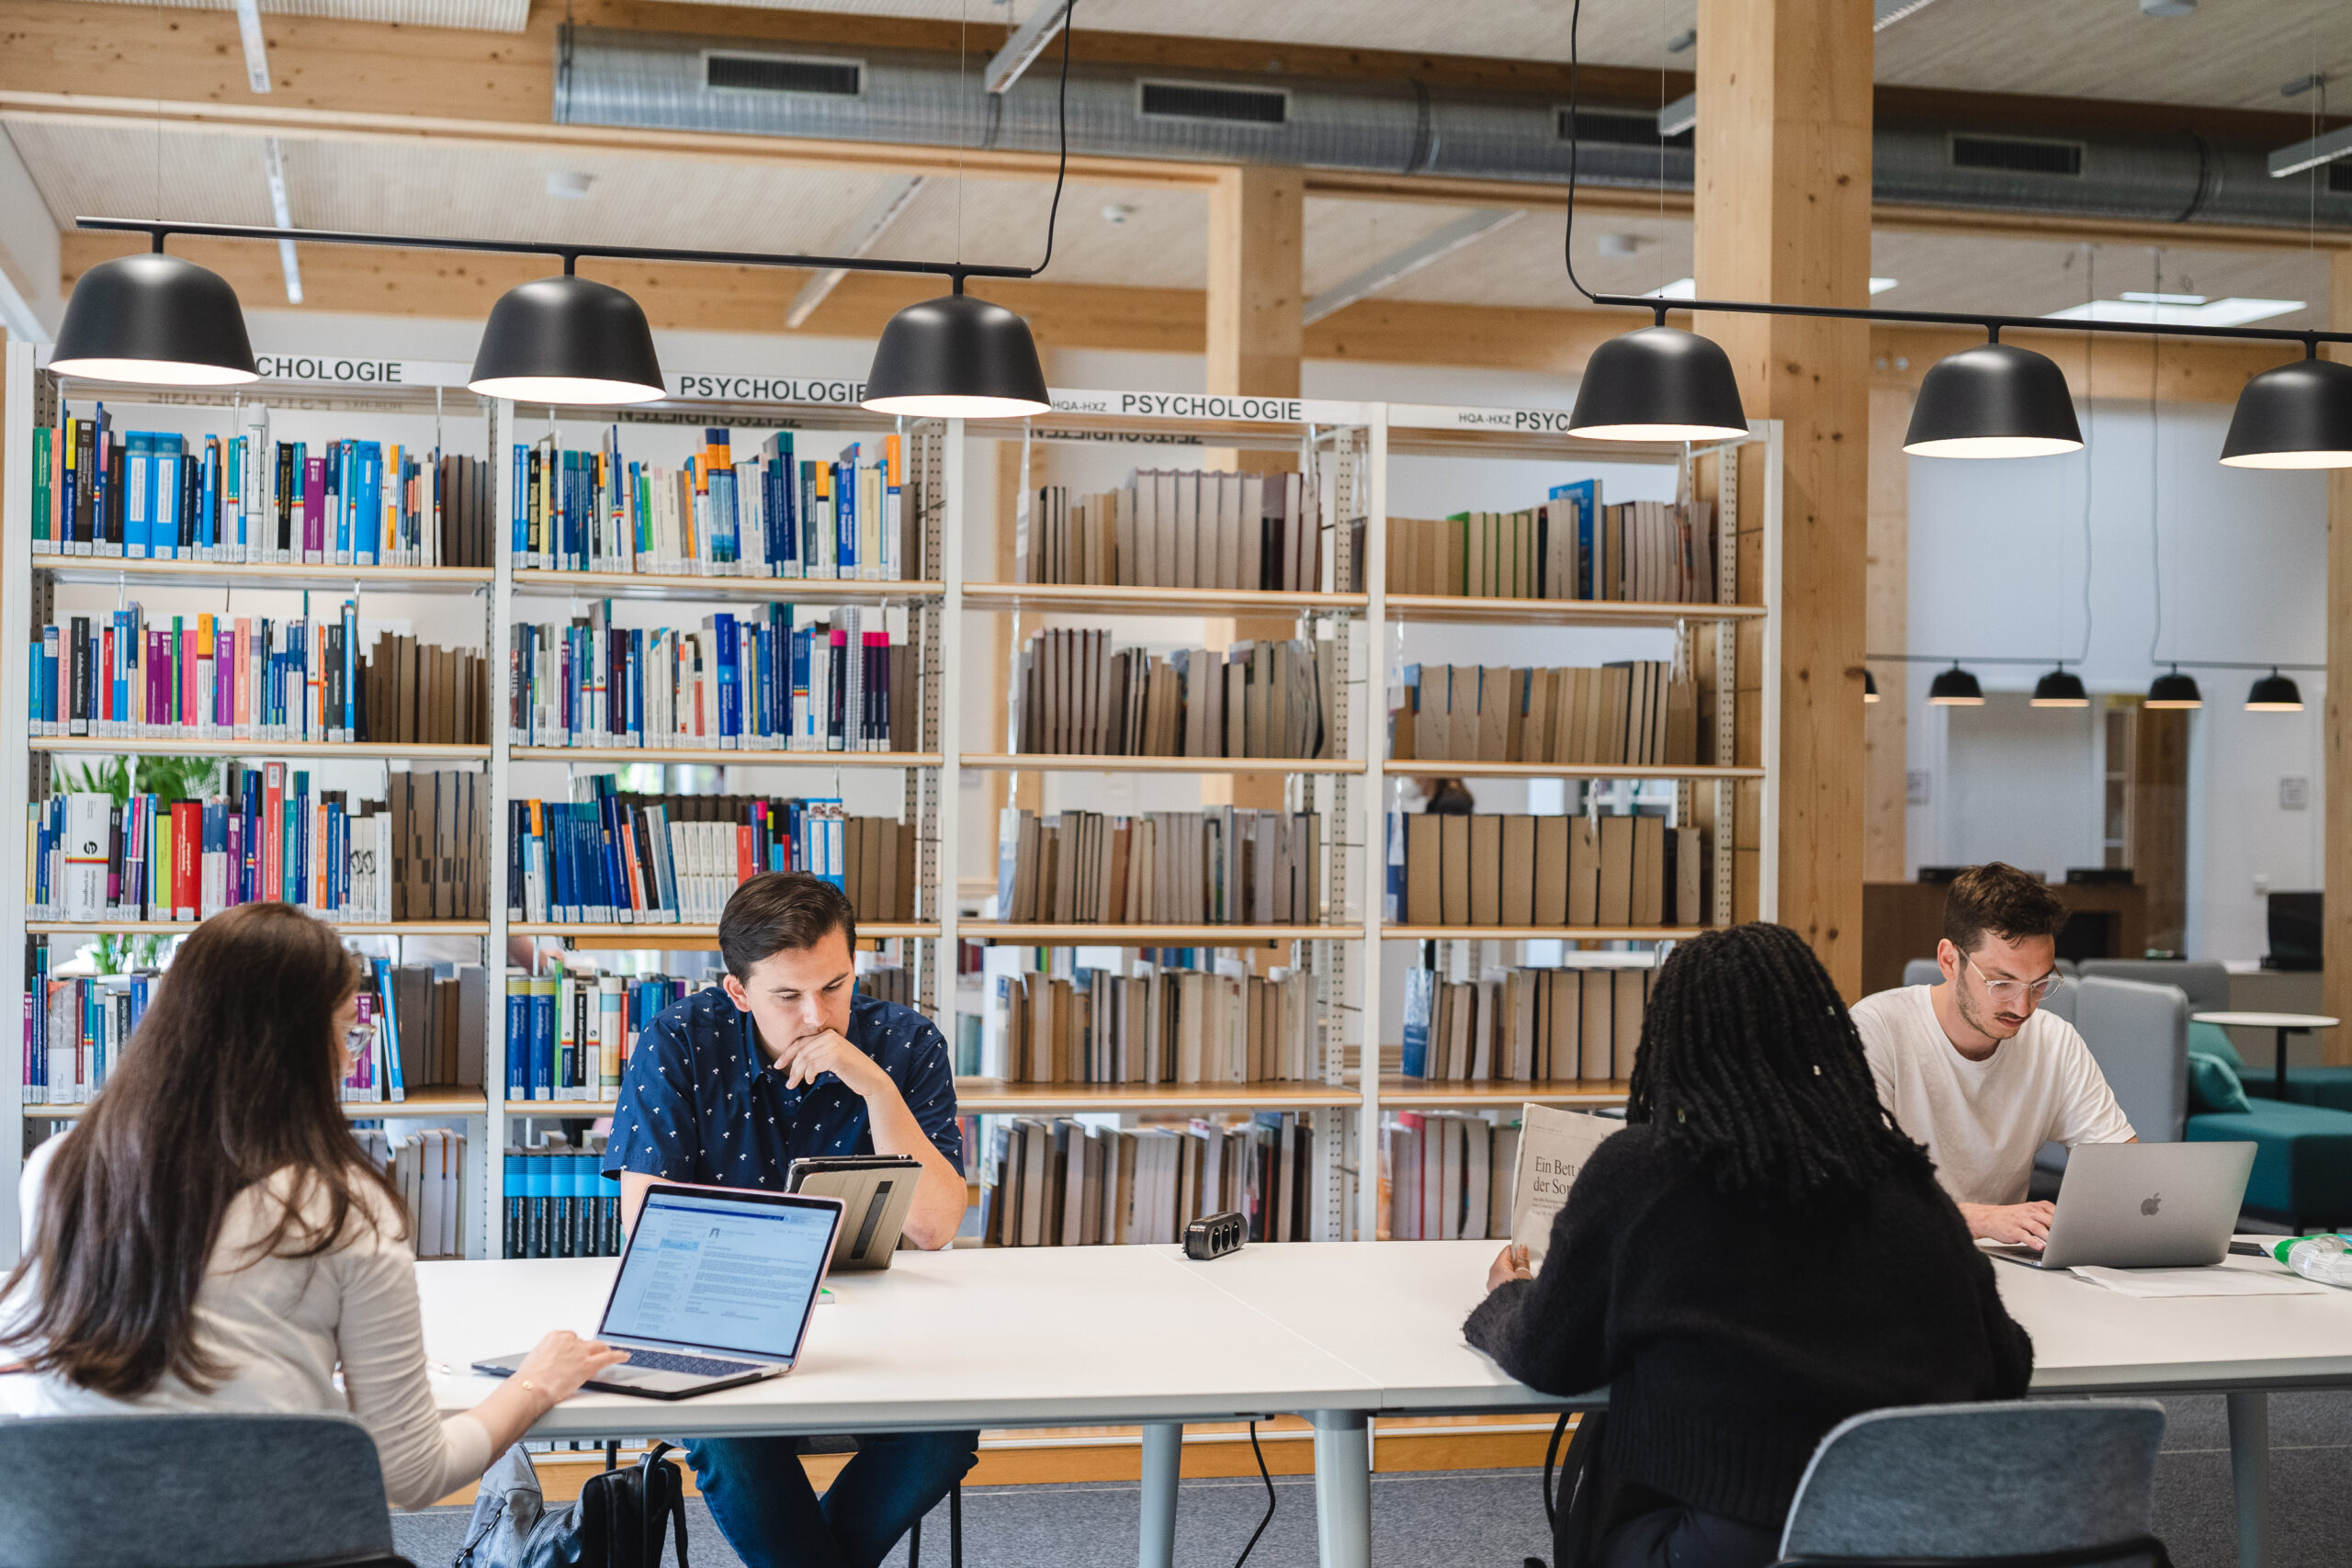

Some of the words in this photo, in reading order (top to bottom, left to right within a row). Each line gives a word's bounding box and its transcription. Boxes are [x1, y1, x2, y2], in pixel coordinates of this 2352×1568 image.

[255, 356, 401, 382] CHOLOGIE
[680, 376, 867, 402] PSYCHOLOGIE
[1122, 394, 1302, 420] PSYCHOLOGIE
[1535, 1156, 1552, 1174] Ein
[1554, 1159, 1575, 1177] Bett
[1533, 1176, 1550, 1193] der
